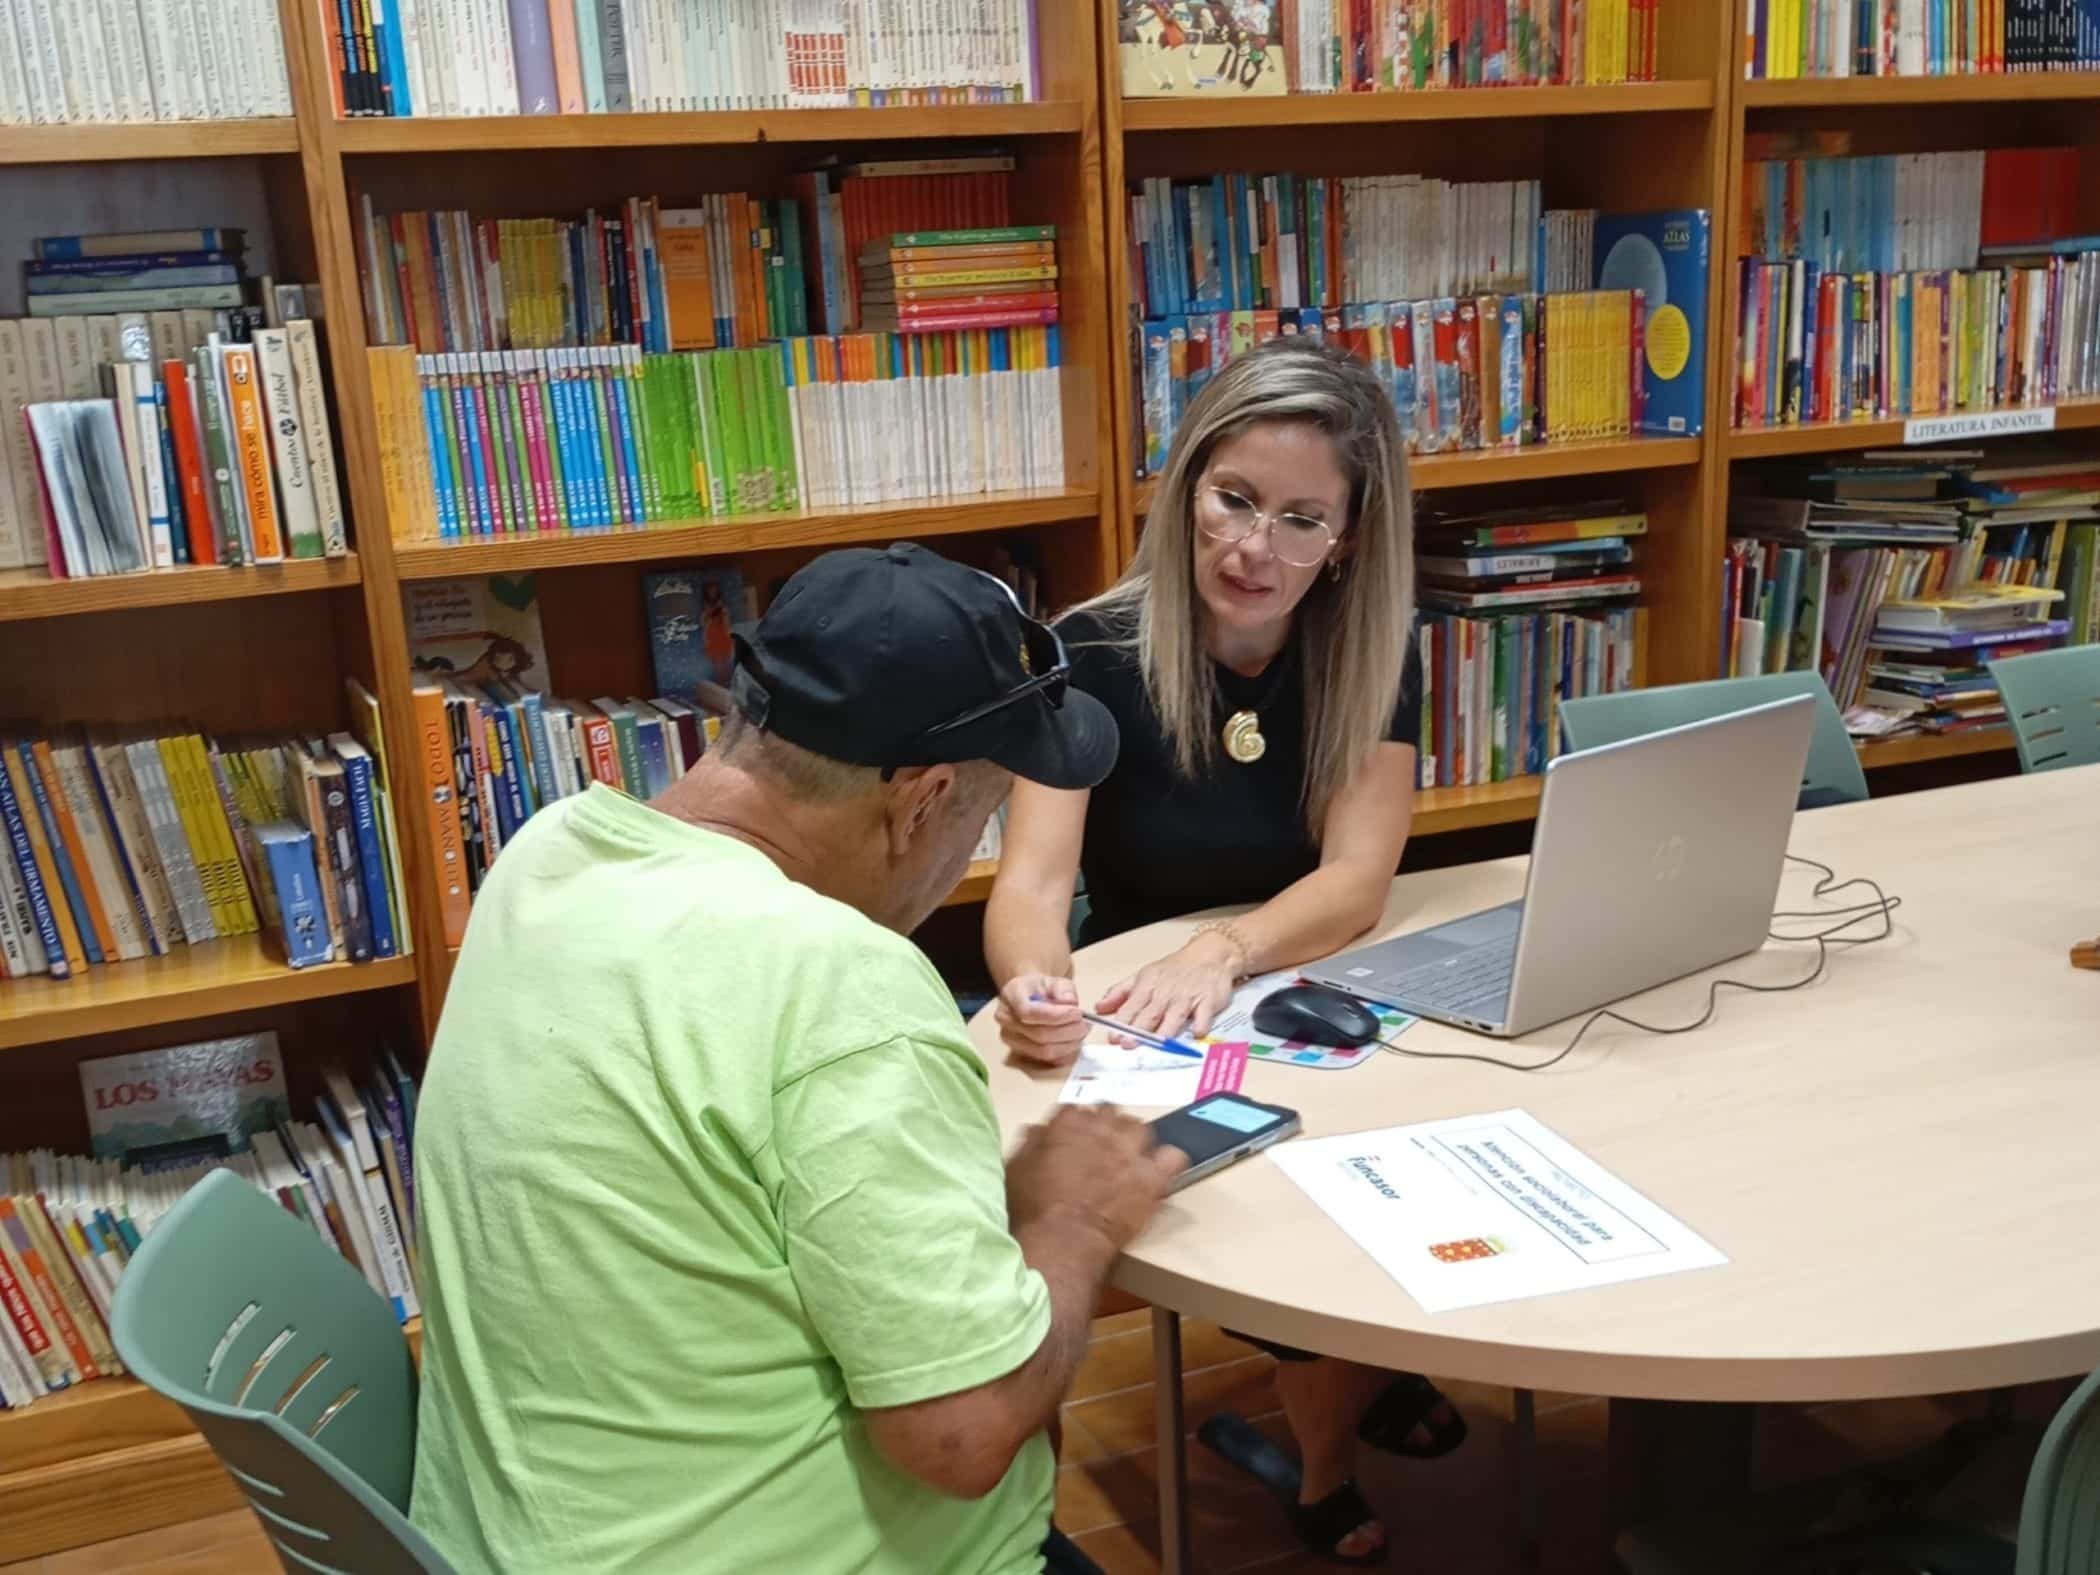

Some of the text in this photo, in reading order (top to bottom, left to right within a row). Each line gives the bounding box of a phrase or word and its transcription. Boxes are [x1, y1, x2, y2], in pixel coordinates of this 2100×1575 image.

[246, 433, 258, 449] se
[1911, 413, 2046, 438] LITERATURA INFANTIL
[247, 451, 264, 487] cómo
[255, 491, 268, 519] mira
[424, 720, 444, 775] TODO
[1, 791, 22, 831] ATLAS
[13, 833, 31, 857] DEL
[22, 859, 58, 945] FIRMAMENTO
[94, 1079, 160, 1110] LOS
[1456, 1144, 1504, 1179] personas
[1500, 1180, 1522, 1194] con
[1519, 1195, 1593, 1245] discapacidad
